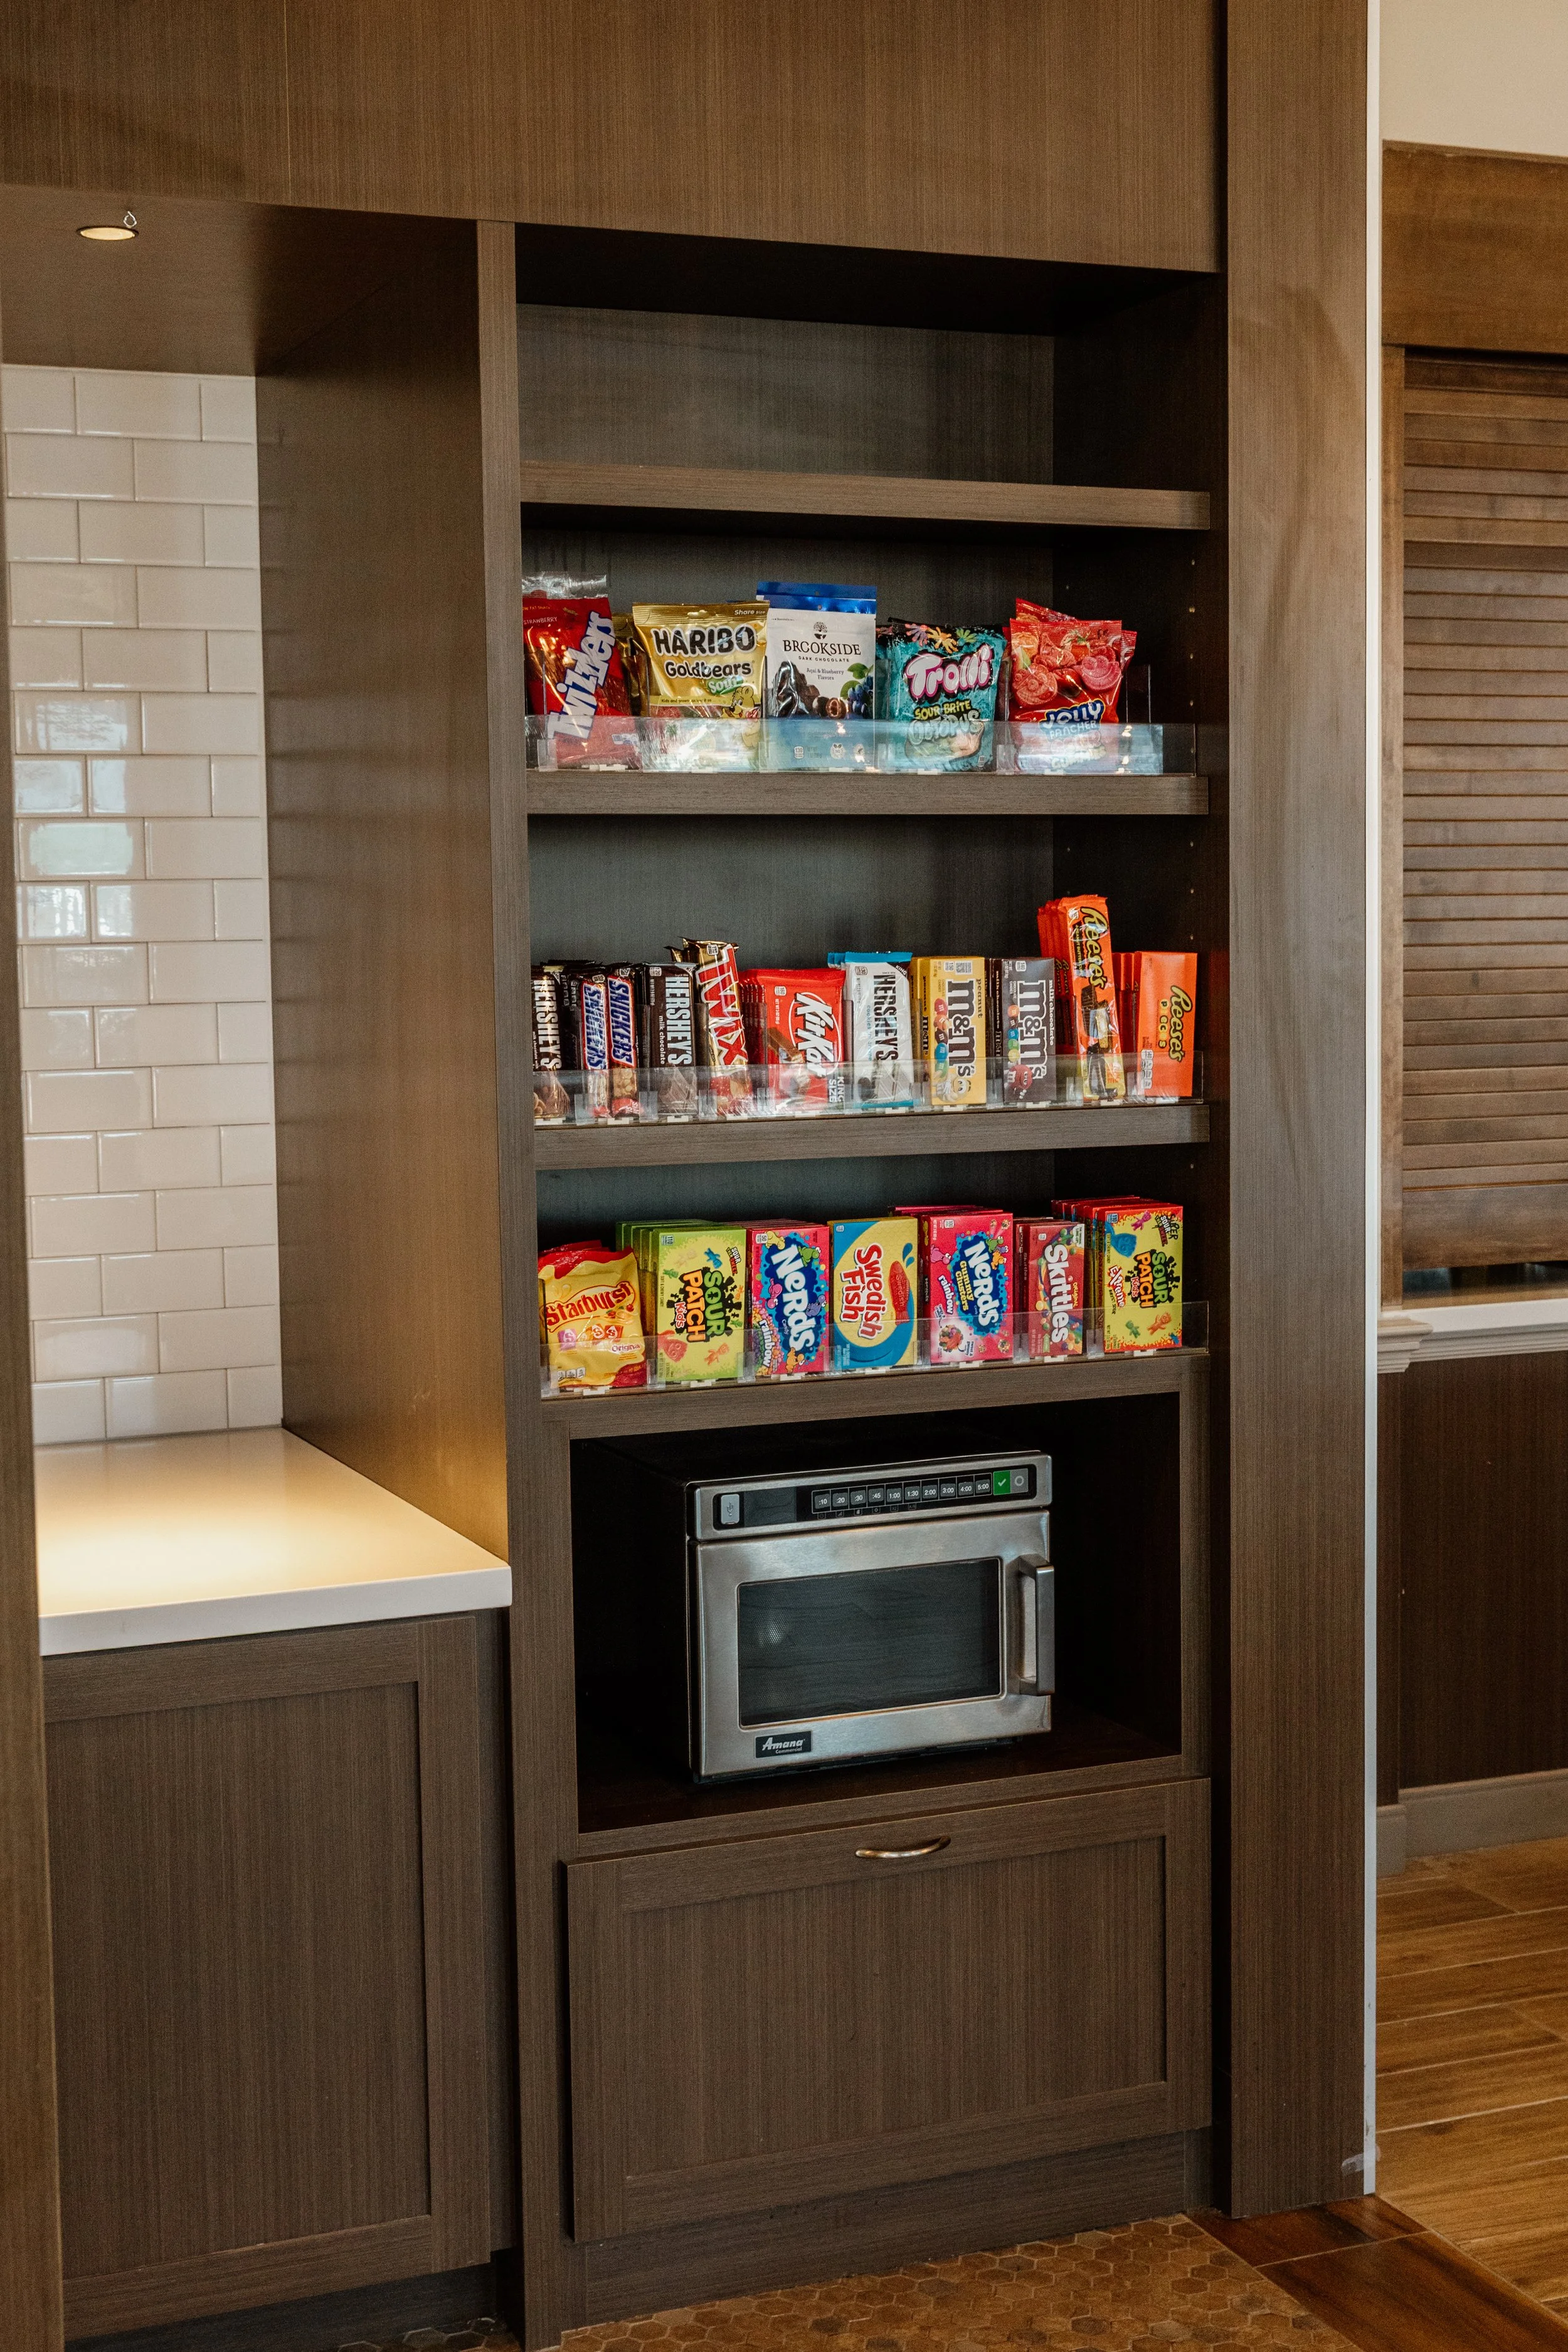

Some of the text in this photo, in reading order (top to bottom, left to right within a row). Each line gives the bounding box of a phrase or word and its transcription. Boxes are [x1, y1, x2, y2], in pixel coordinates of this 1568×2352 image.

[523, 617, 557, 625] STRAWBERRY
[652, 626, 755, 655] HARIBO
[665, 660, 752, 678] Goldbears
[782, 640, 862, 656] BROOKSIDE
[906, 644, 992, 697] Trolli
[914, 706, 940, 720] SOUR
[1042, 703, 1101, 729] JOLLY
[1049, 720, 1097, 739] RANCHER
[895, 965, 907, 975] KING
[1080, 906, 1109, 990] Reese's
[533, 980, 562, 1069] HERSHEY'S
[584, 985, 607, 1070] SNICKERS
[608, 980, 633, 1064] SNICKERS
[665, 976, 692, 1064] HERSHEY'S
[697, 947, 749, 1066] TWIX
[873, 974, 899, 1061] HERSHEY'S
[947, 980, 975, 1077] m&m's
[1018, 980, 1047, 1079] m&m's
[1168, 985, 1193, 1063] Reese's
[829, 1079, 837, 1103] SIZE
[1160, 1215, 1171, 1233] SOUR
[731, 1247, 741, 1264] SOUR
[1136, 1251, 1154, 1307] PATCH
[1151, 1252, 1168, 1303] SOUR
[545, 1283, 631, 1327] Starburst
[682, 1270, 706, 1342] PATCH
[703, 1271, 726, 1337] SOUR
[842, 1266, 866, 1320] Fish
[856, 1244, 886, 1337] Swedish
[895, 1274, 905, 1307] Swedish
[938, 1274, 955, 1314] rainbow
[1044, 1244, 1073, 1343] Skittles
[1131, 1276, 1140, 1298] Kids
[674, 1301, 687, 1328] Kids
[758, 1318, 774, 1367] rainbow
[761, 1737, 803, 1751] Amana
[775, 1746, 802, 1754] Commercial
